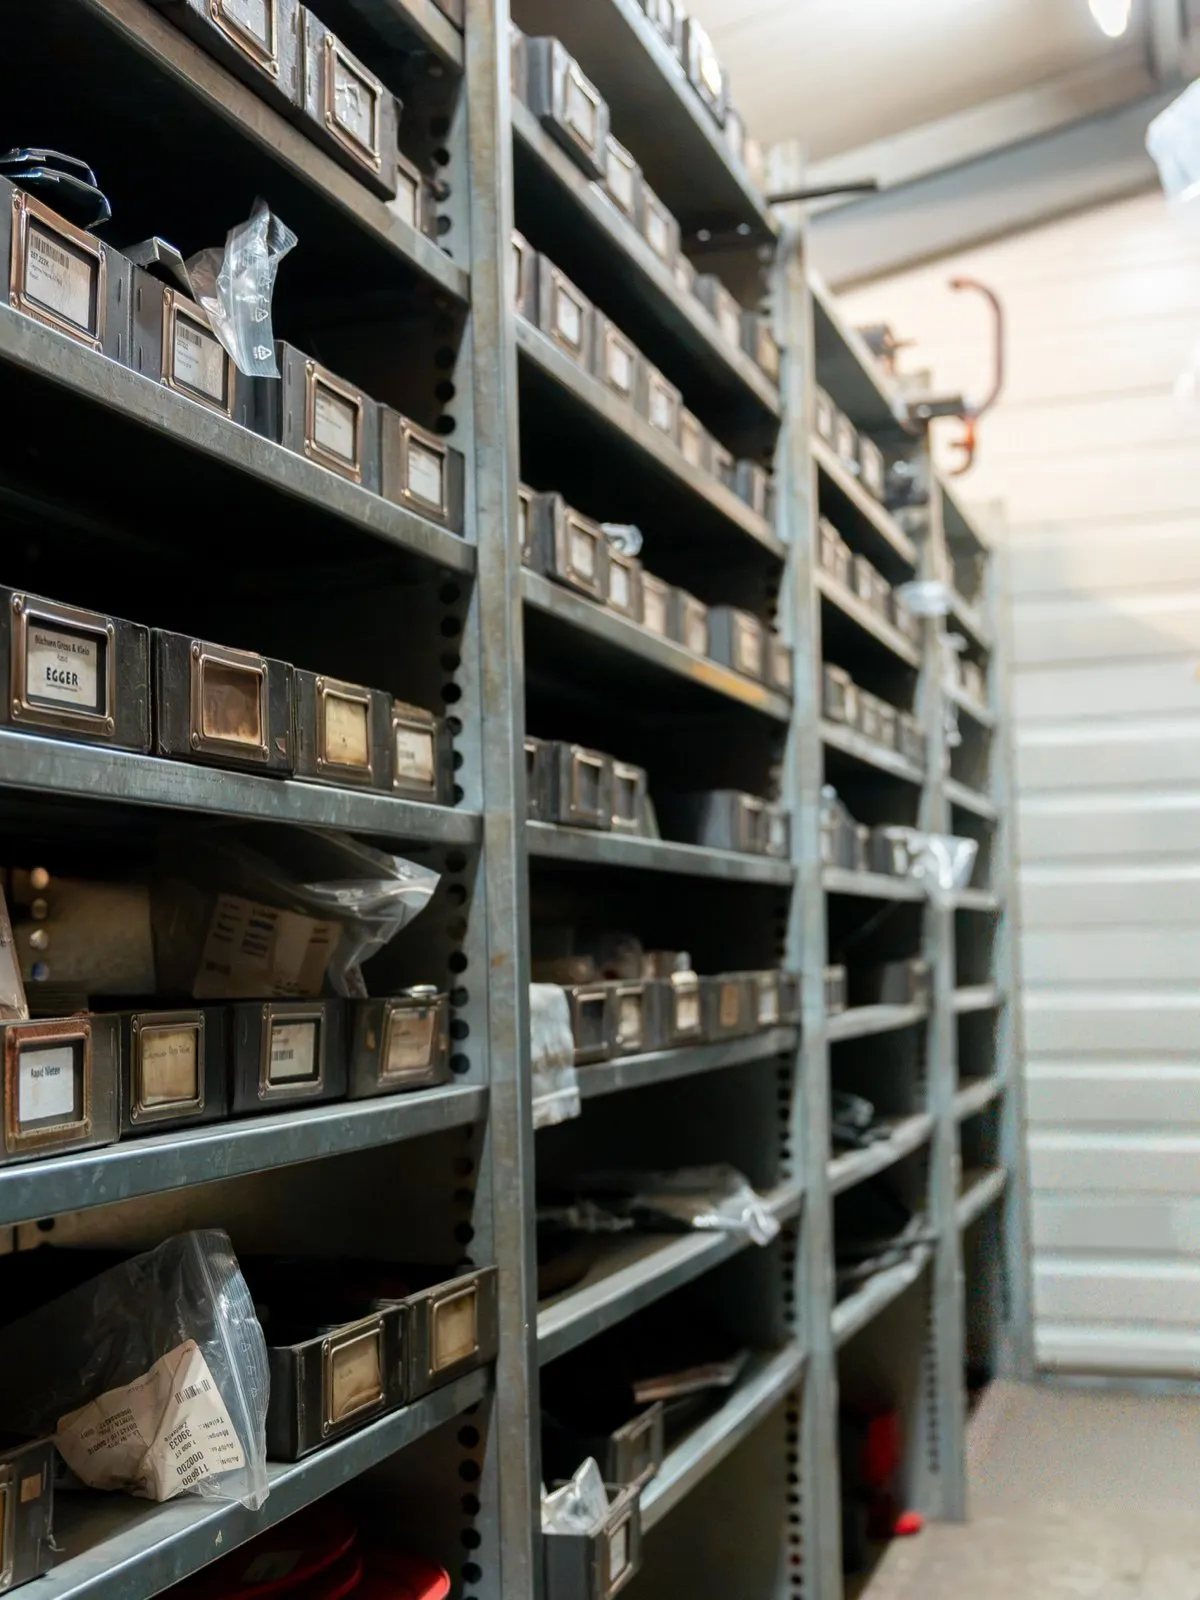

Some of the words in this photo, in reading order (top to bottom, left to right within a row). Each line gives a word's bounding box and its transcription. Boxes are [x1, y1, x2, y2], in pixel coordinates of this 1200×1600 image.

[46, 667, 78, 686] EGGER
[168, 1429, 192, 1449] 39033
[176, 1450, 204, 1475] 000200
[181, 1463, 209, 1486] 118680
